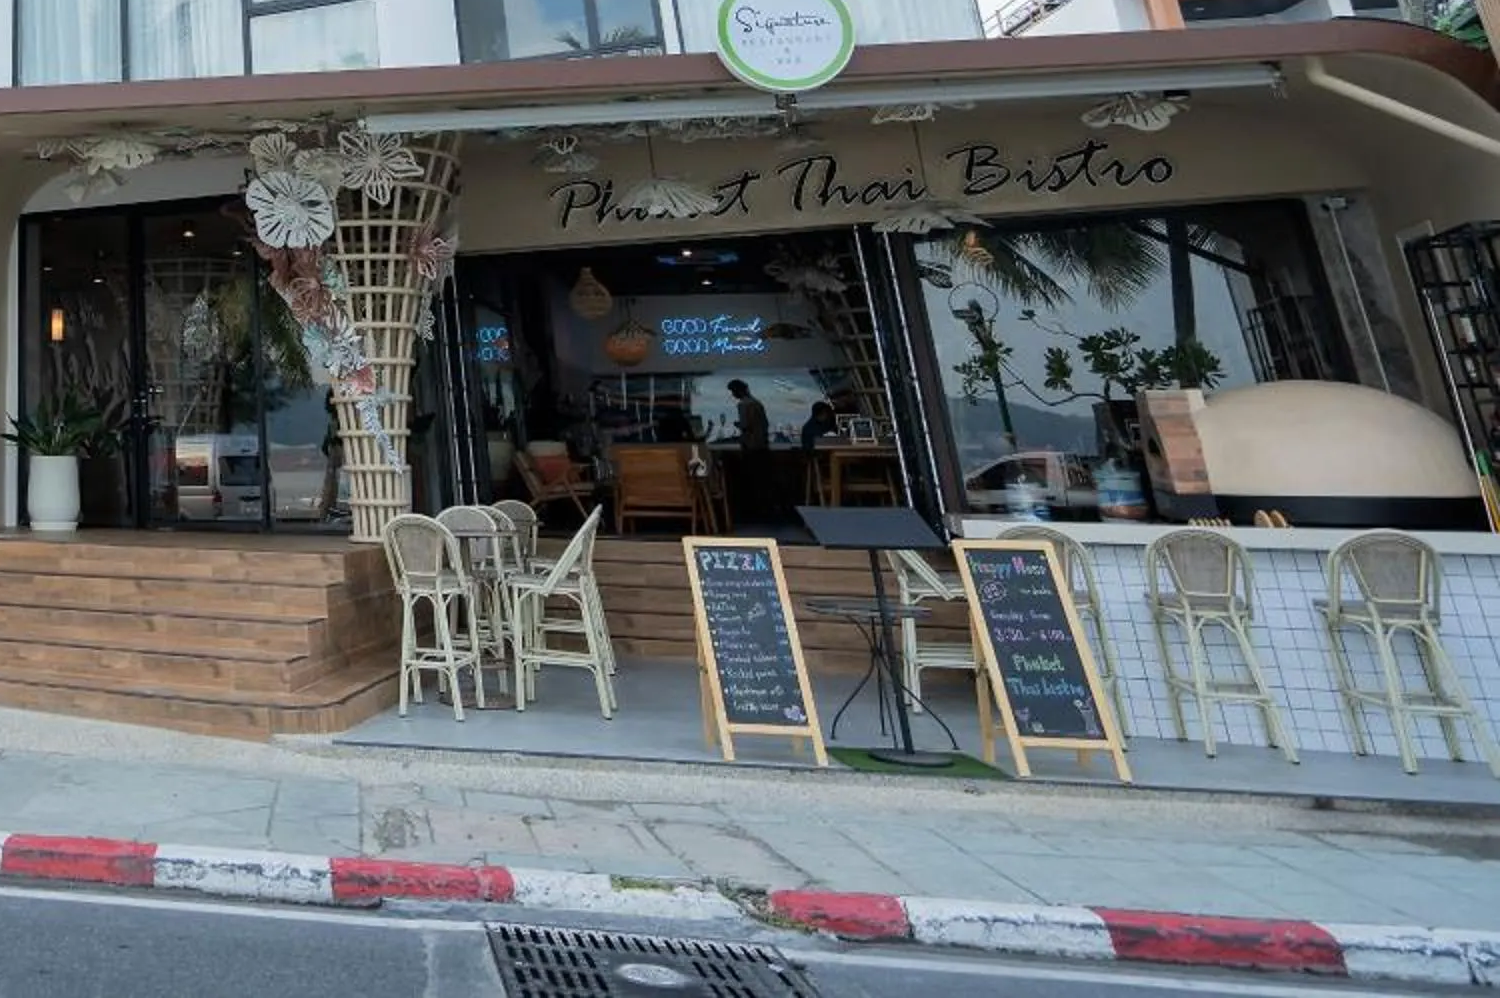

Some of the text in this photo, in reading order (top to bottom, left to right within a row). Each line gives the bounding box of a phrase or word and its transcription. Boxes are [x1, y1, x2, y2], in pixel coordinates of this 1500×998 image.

[735, 6, 832, 35] Signature
[550, 138, 1173, 228] Phut Thai Bistro
[699, 551, 769, 571] PIZZA
